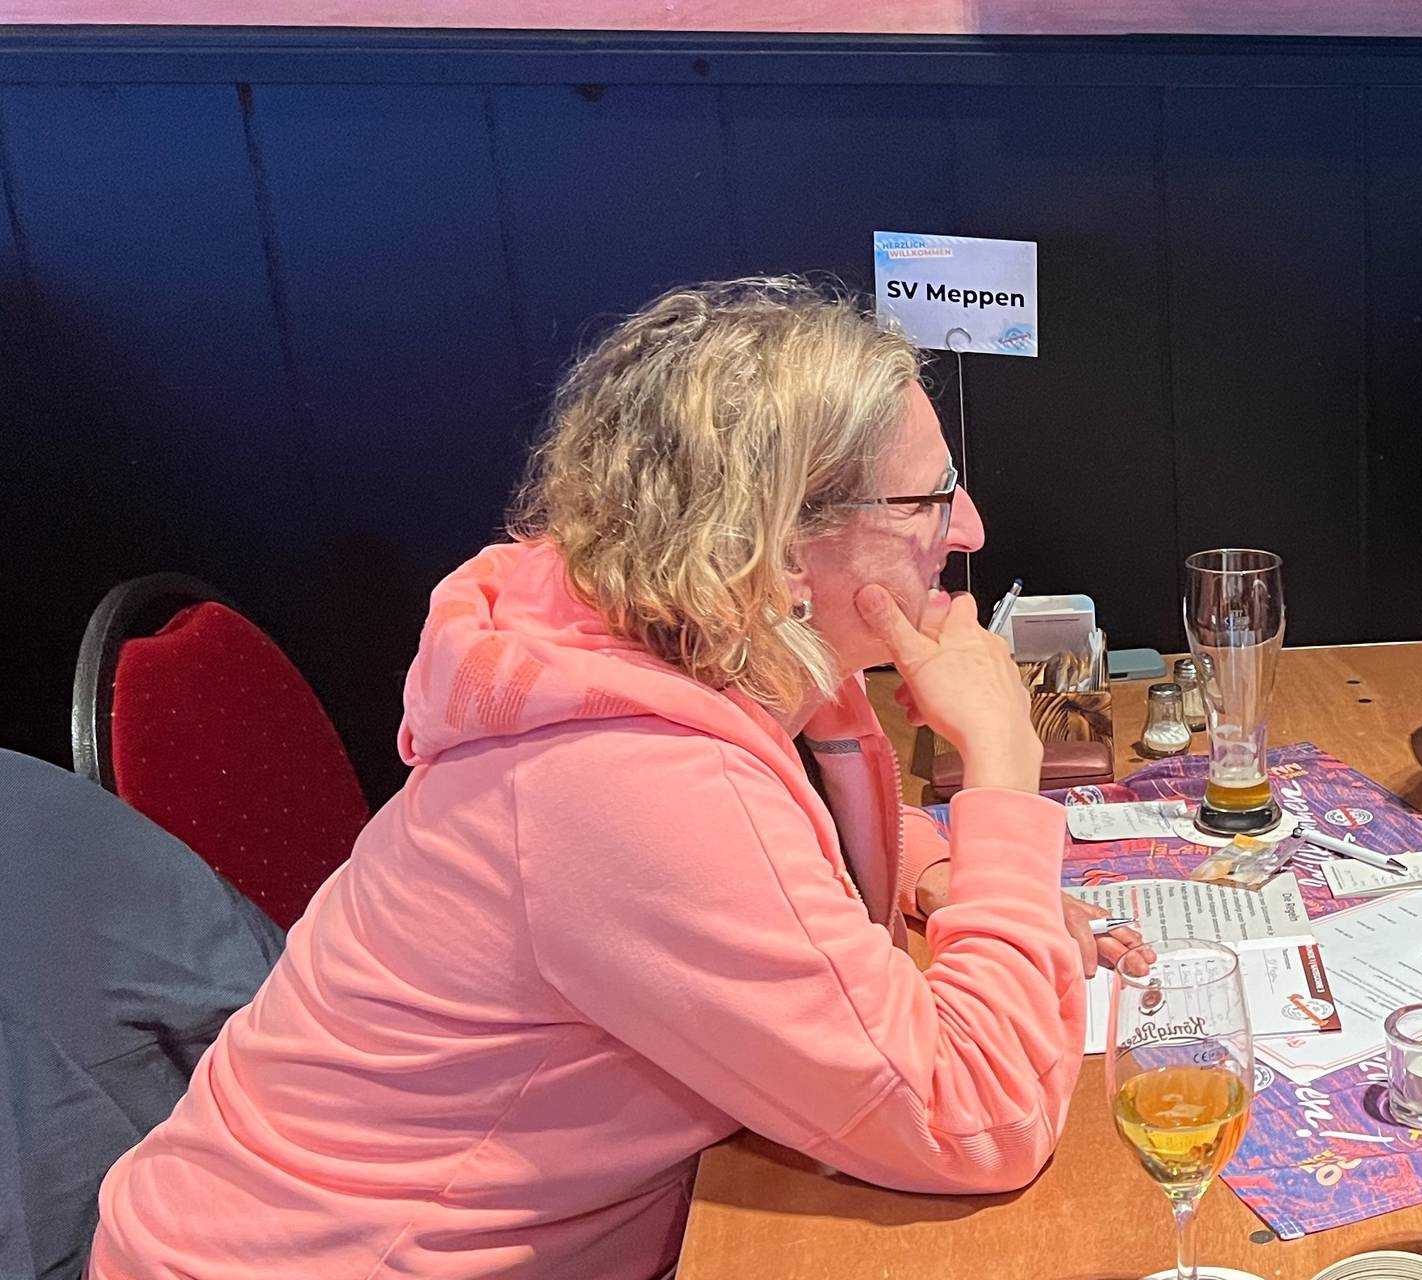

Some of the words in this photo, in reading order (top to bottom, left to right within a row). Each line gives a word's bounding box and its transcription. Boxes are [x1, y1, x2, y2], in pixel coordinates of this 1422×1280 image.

[882, 240, 926, 250] HERZLICH
[889, 249, 951, 258] WILLKOMMEN
[887, 280, 918, 299] SV
[926, 283, 1025, 309] Meppen
[1281, 892, 1294, 903] Die
[1284, 902, 1298, 921] Regeln
